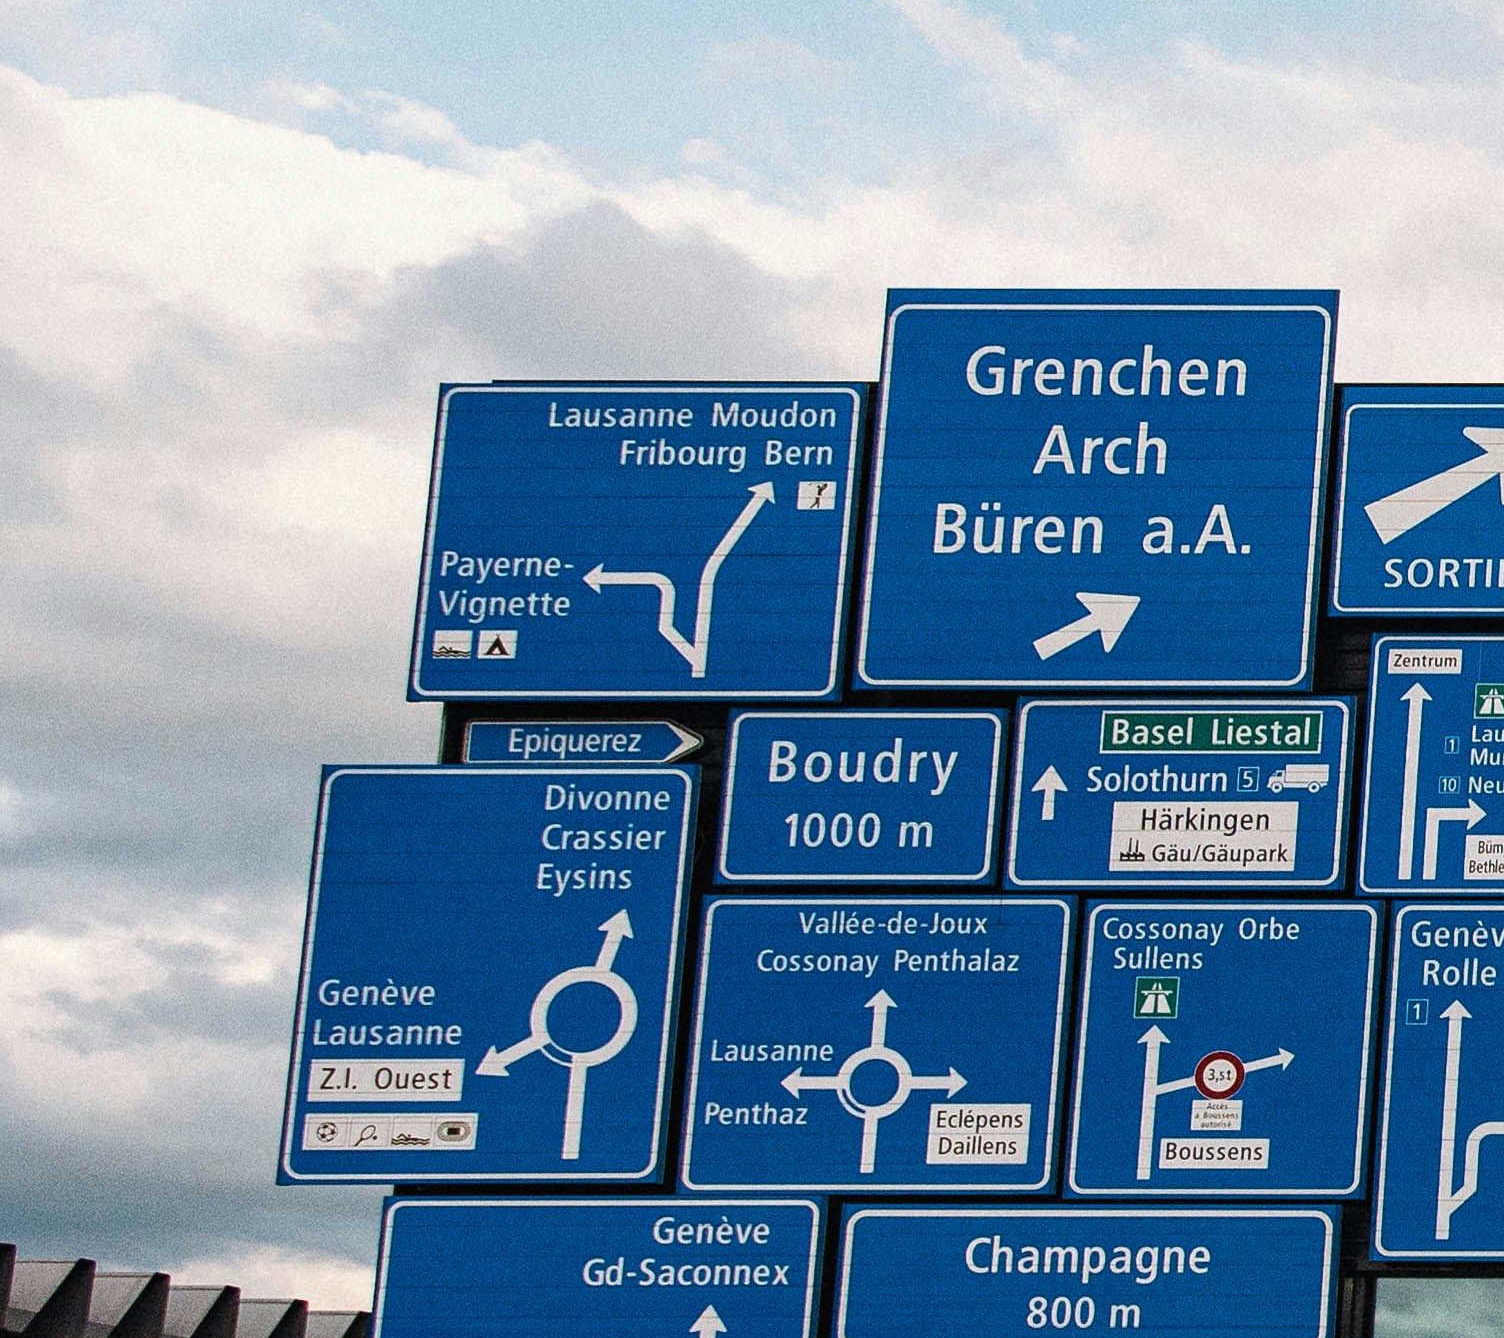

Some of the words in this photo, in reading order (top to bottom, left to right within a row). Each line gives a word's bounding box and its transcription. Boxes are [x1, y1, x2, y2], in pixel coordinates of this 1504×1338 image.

[966, 344, 1247, 397] Grenchen
[548, 401, 694, 428] Lausanne
[711, 400, 836, 428] Moudon
[933, 501, 1103, 554] Büren
[1142, 504, 1251, 555] a.A.
[438, 589, 571, 617] Vignette
[768, 737, 959, 796] Boudry
[1141, 806, 1270, 837] Härkingen
[541, 823, 667, 851] Crassier
[799, 910, 988, 935] Vallée-de-Joux
[1113, 945, 1203, 970] Sullens
[710, 1039, 834, 1062] Lausanne
[374, 1067, 453, 1090] Ouest
[936, 1108, 1024, 1135] Eclépens
[1165, 1141, 1263, 1161] Boussens
[582, 1256, 789, 1287] Gd-Saconnex
[1026, 1296, 1095, 1329] 800
[1109, 1304, 1141, 1328] m
